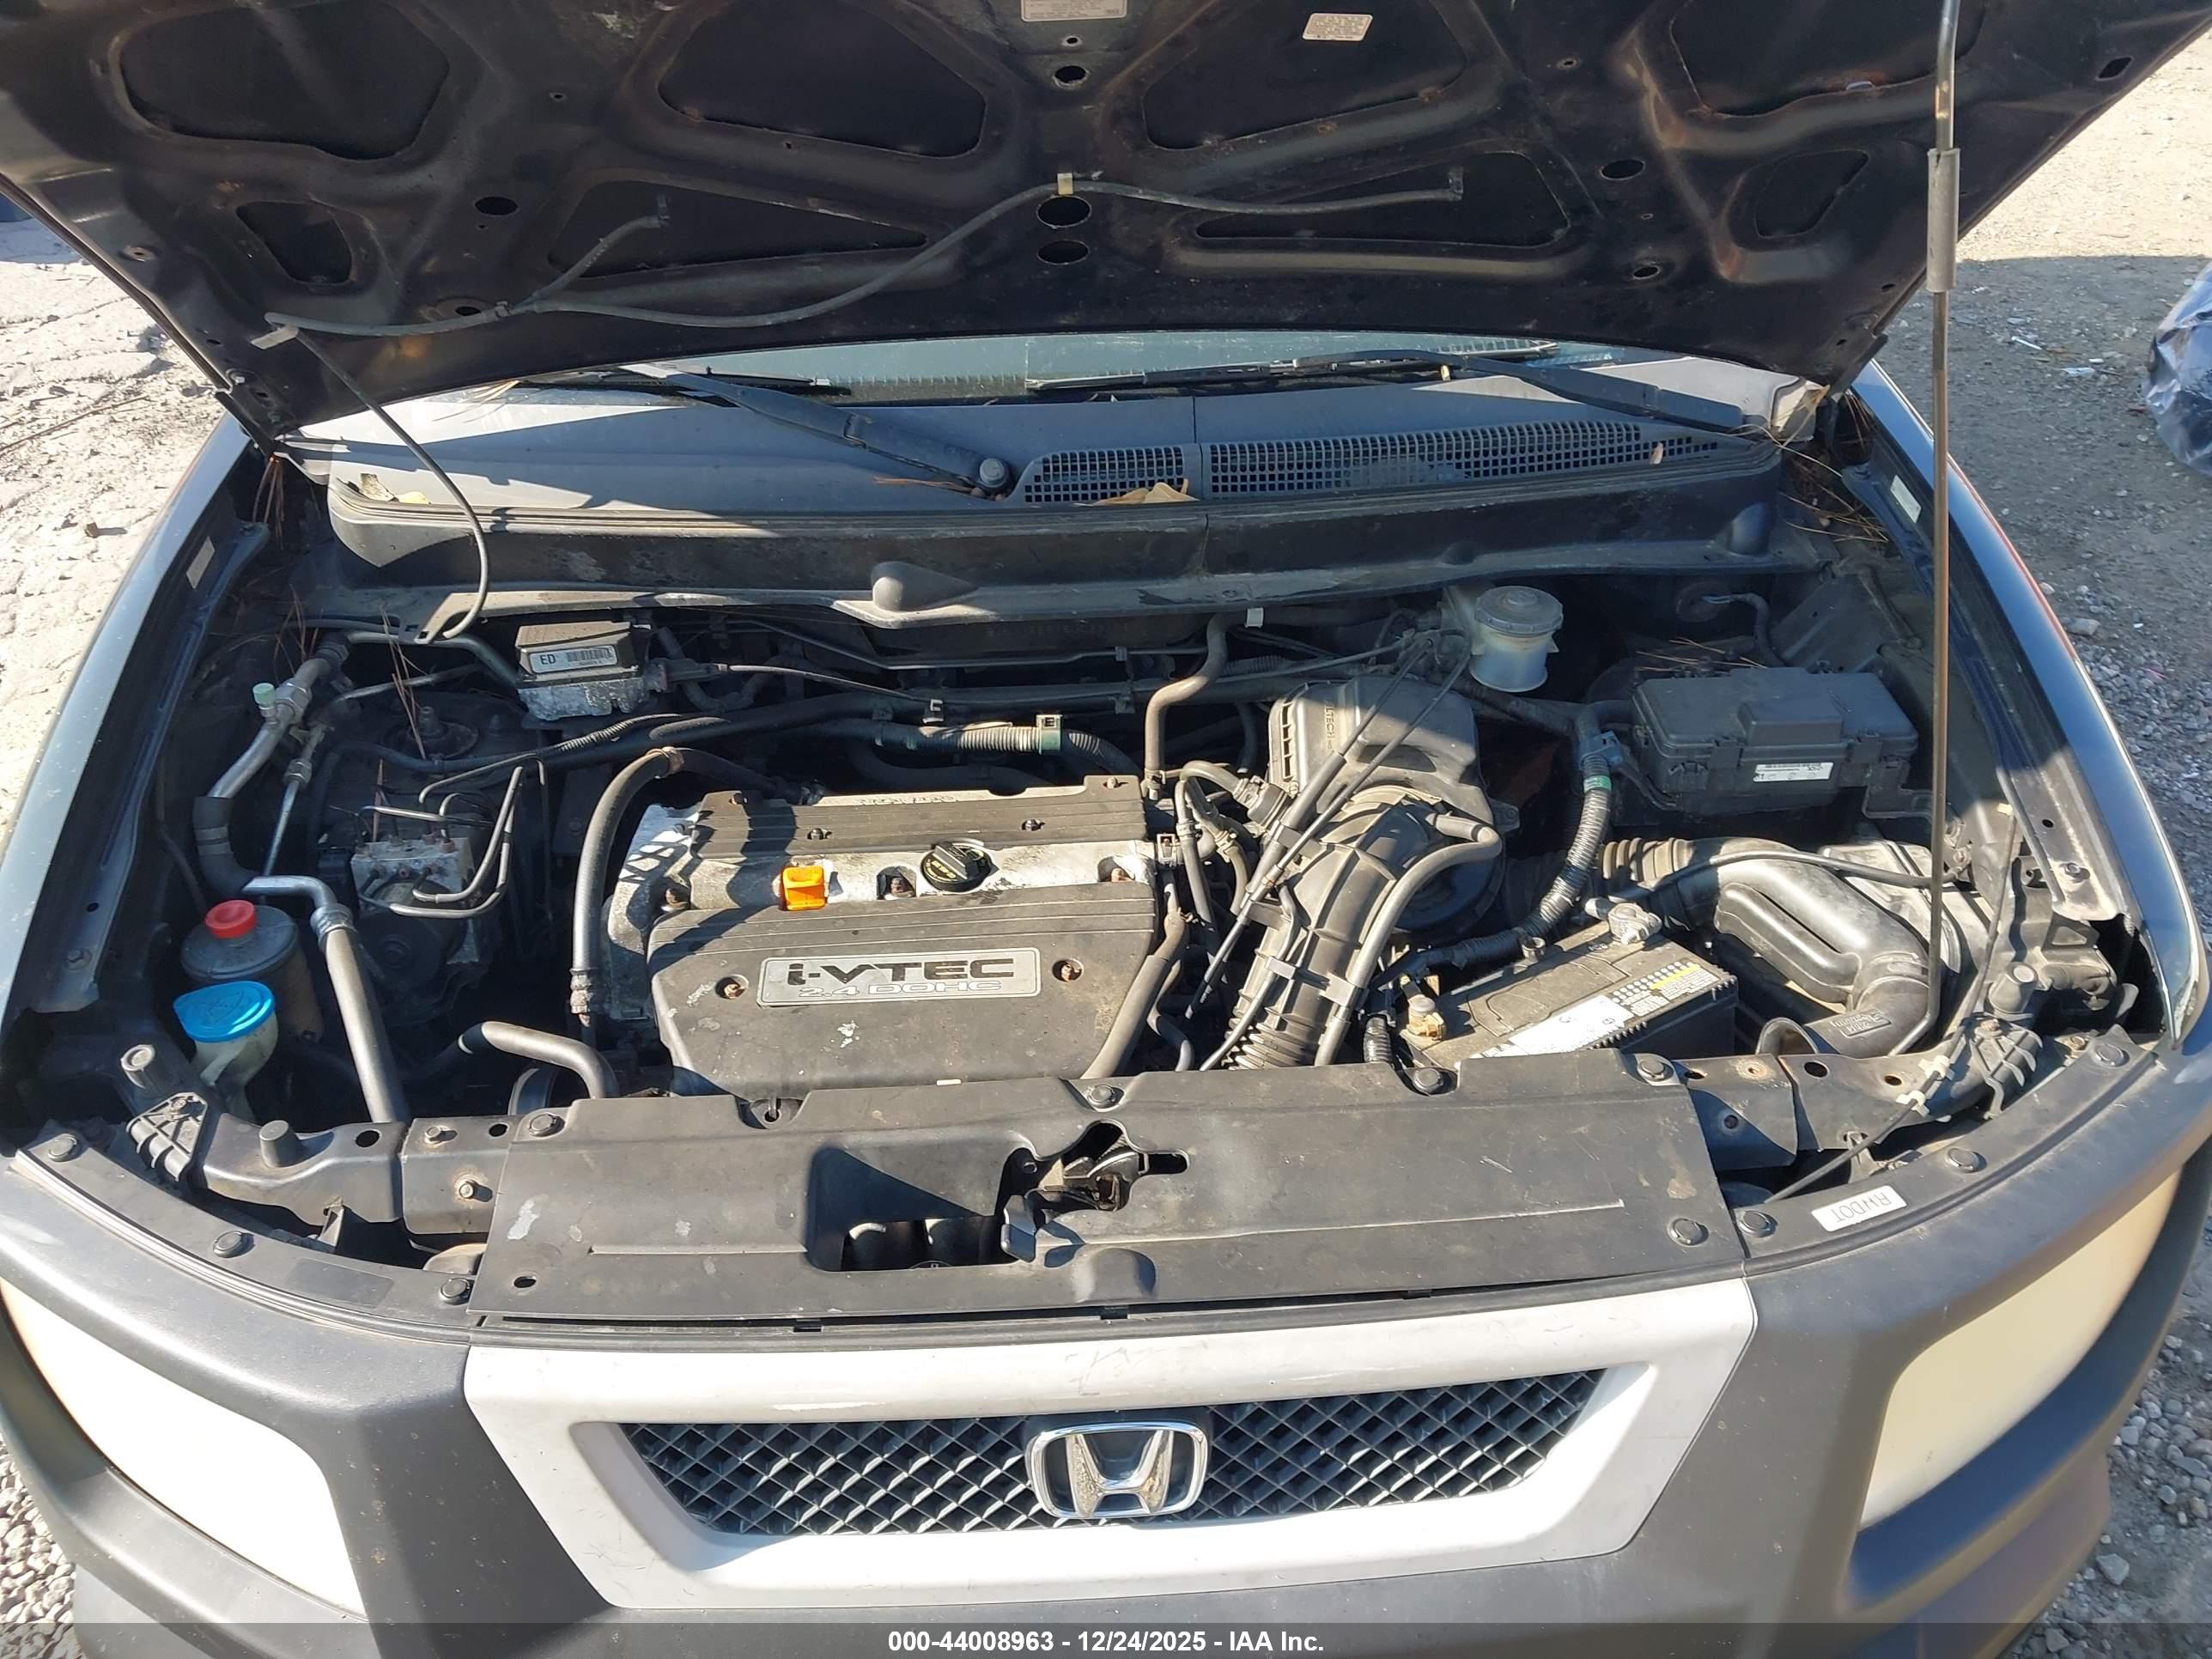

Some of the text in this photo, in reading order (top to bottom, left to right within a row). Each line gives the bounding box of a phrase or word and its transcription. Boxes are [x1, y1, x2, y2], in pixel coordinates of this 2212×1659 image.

[539, 653, 556, 665] ED
[787, 958, 1014, 986] i-VTEC
[799, 981, 1002, 998] 2.4 DOHC
